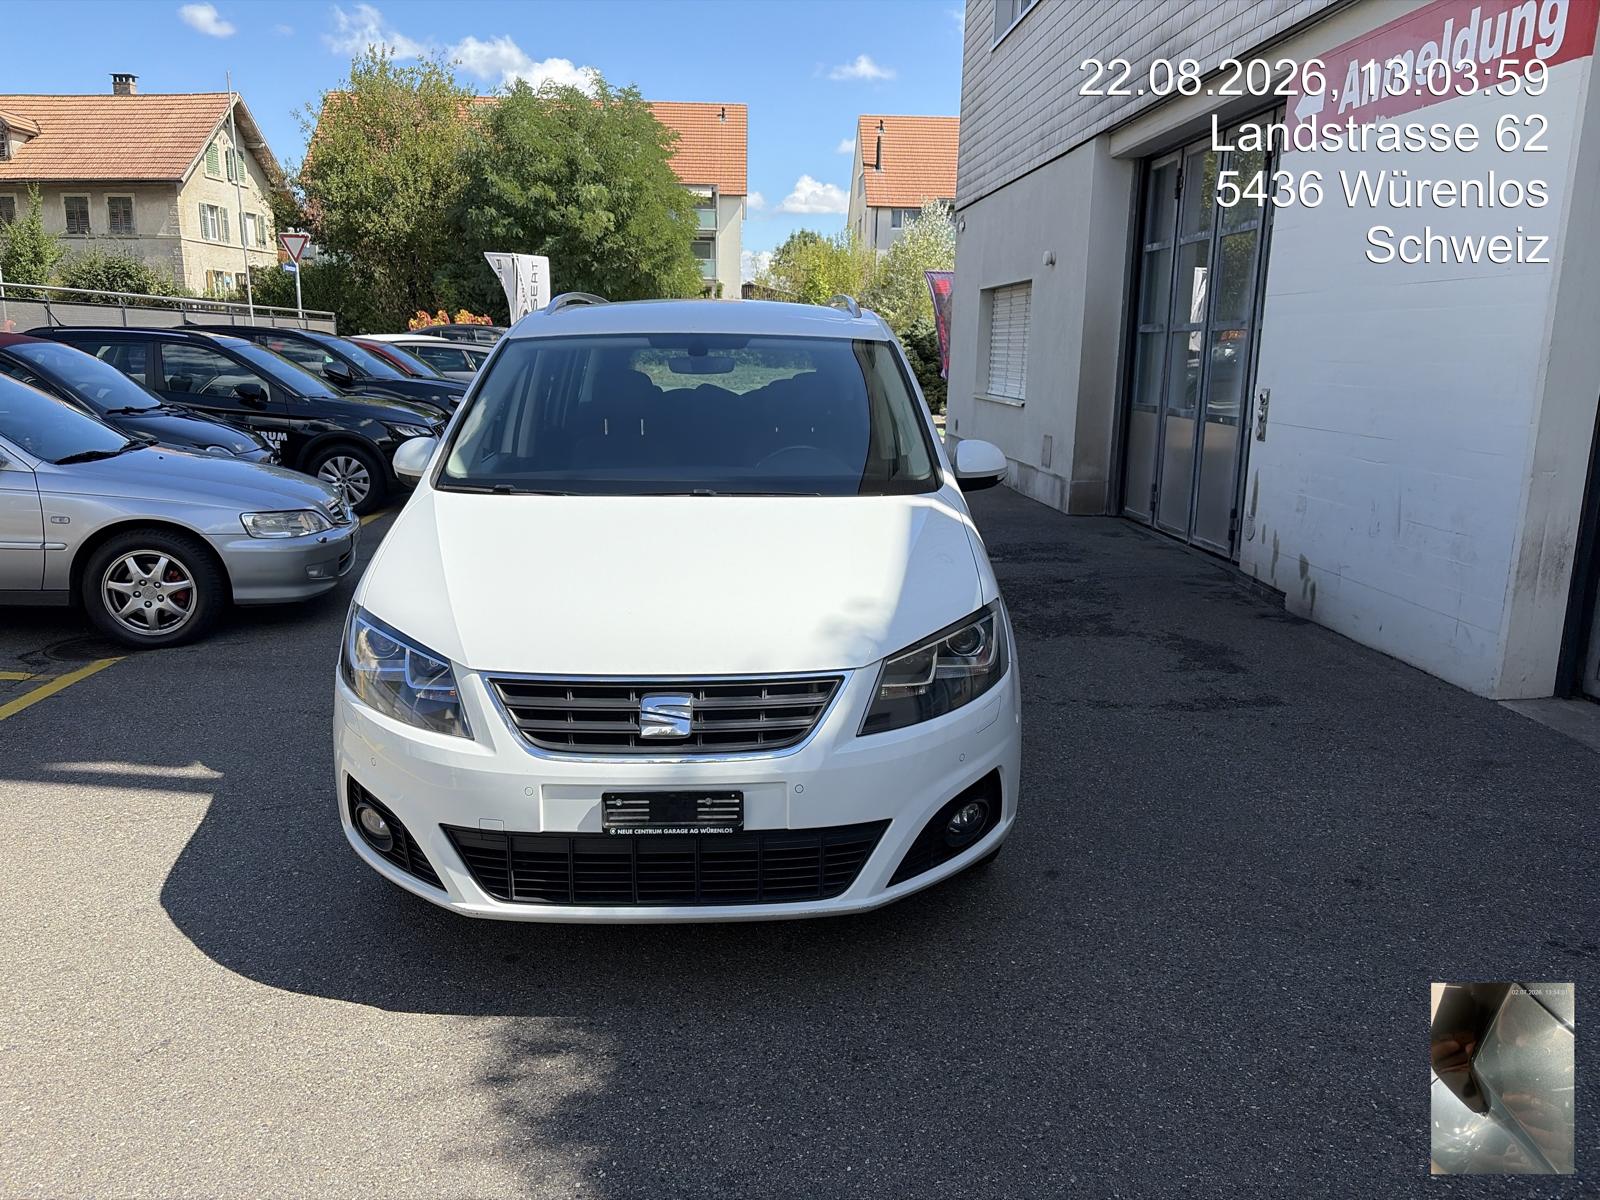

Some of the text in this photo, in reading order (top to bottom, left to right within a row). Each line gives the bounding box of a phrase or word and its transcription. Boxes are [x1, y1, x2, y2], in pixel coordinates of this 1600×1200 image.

[1338, 0, 1569, 114] Anmeldung
[530, 261, 539, 311] SEAT
[700, 826, 733, 834] WÜRENLOS
